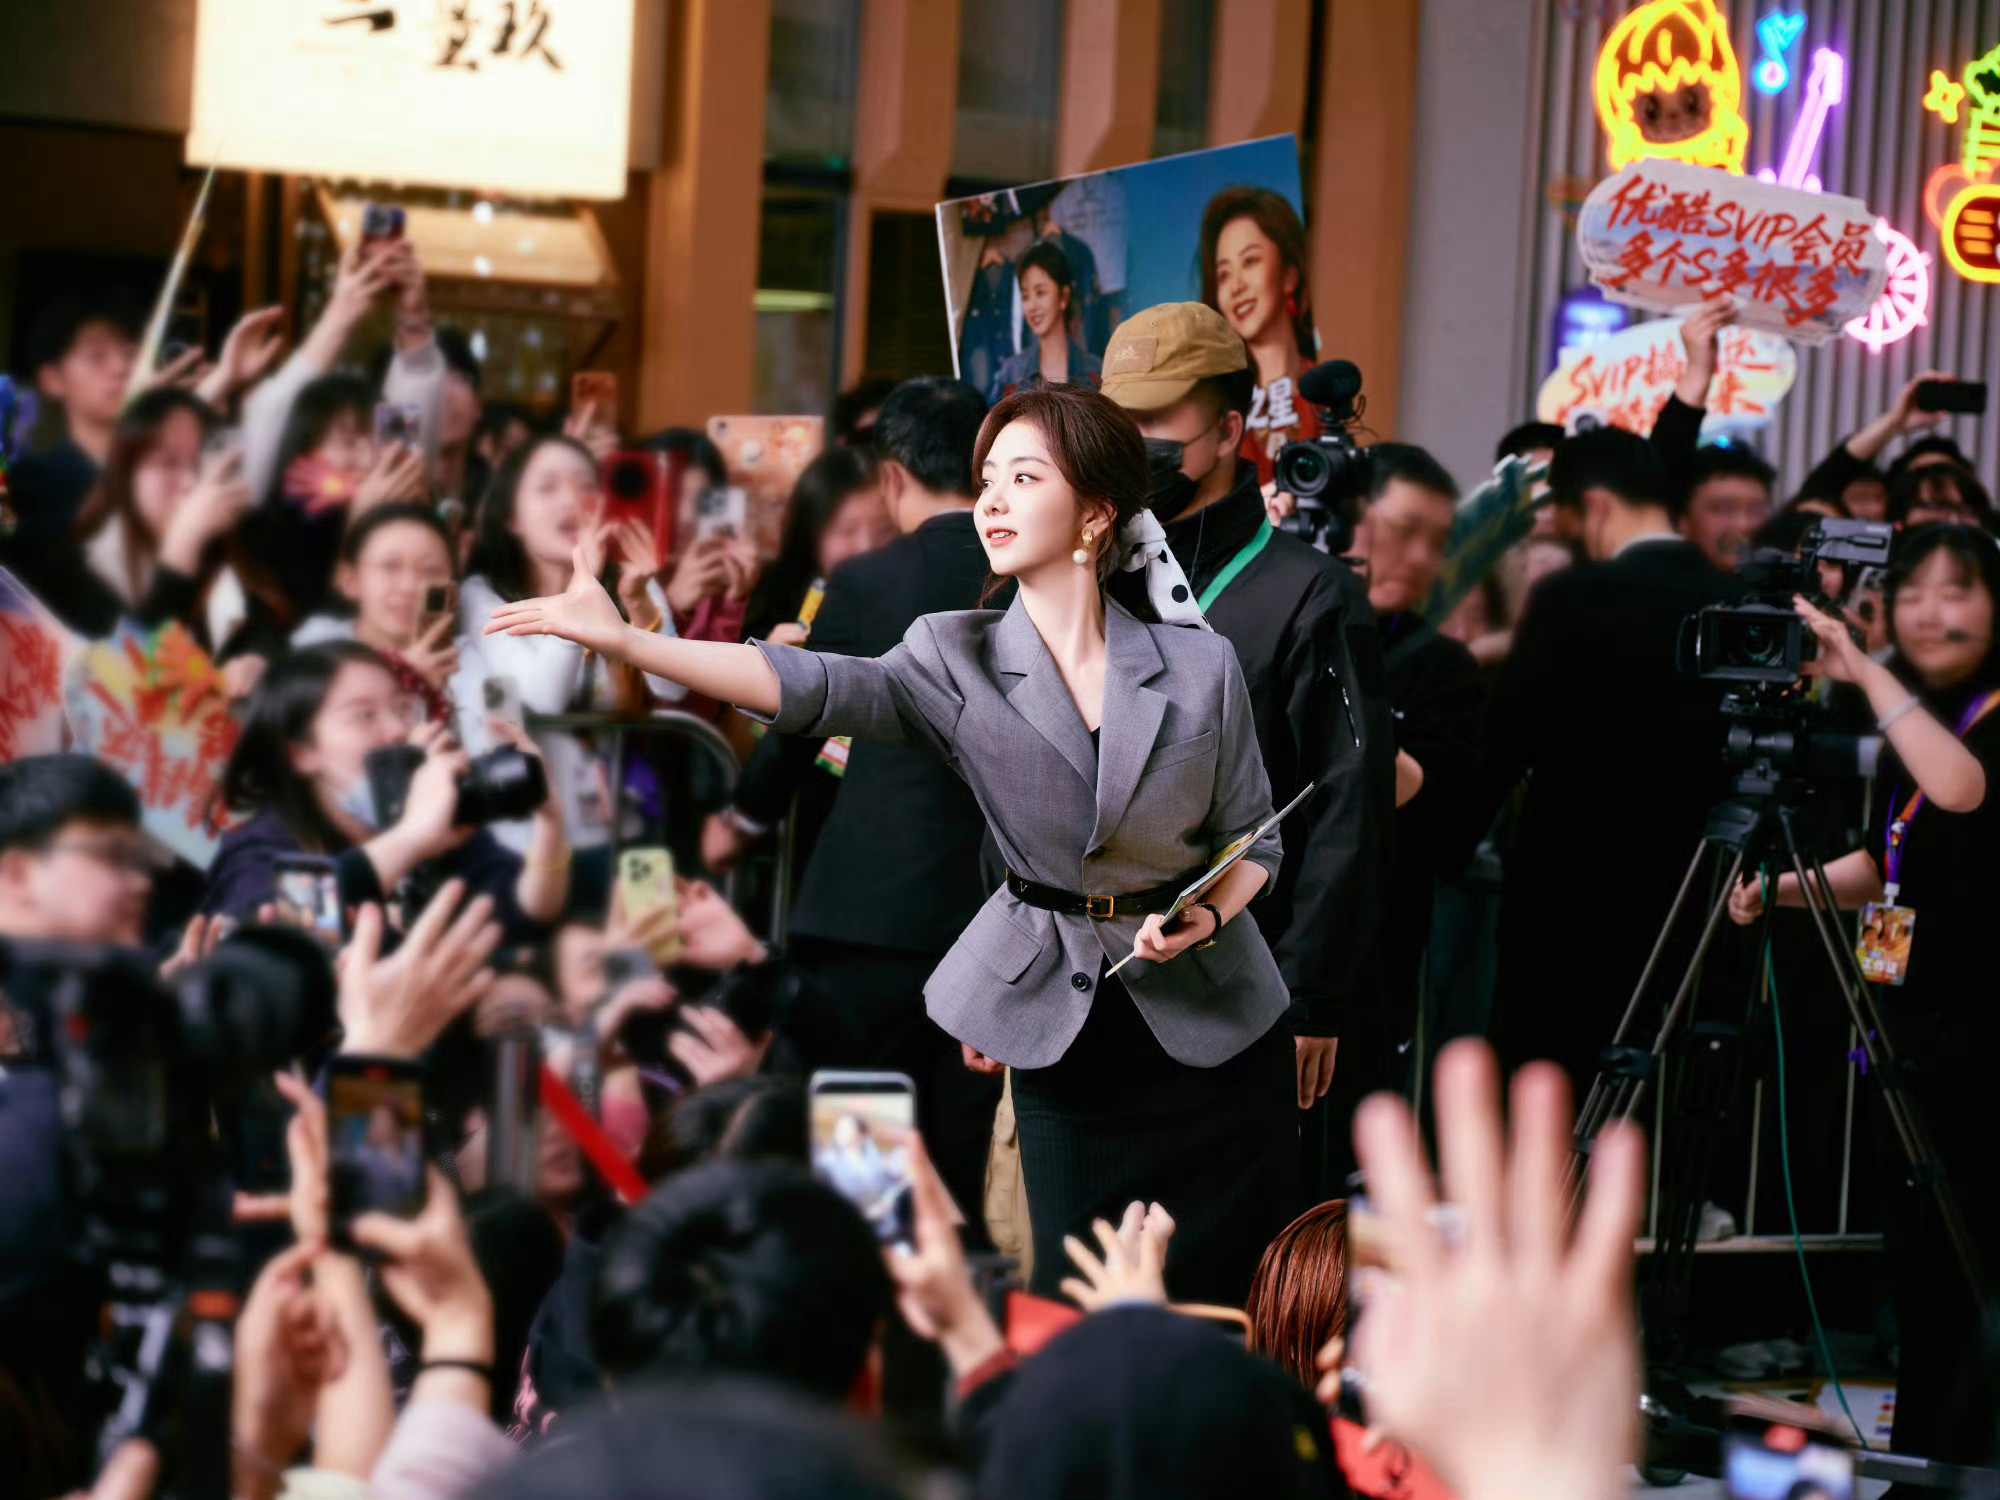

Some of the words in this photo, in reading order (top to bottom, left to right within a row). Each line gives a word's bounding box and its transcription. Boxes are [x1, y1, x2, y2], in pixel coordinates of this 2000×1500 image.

[1607, 173, 1871, 277] 优酷SVIP会员
[1601, 229, 1839, 327] 多个S多很多
